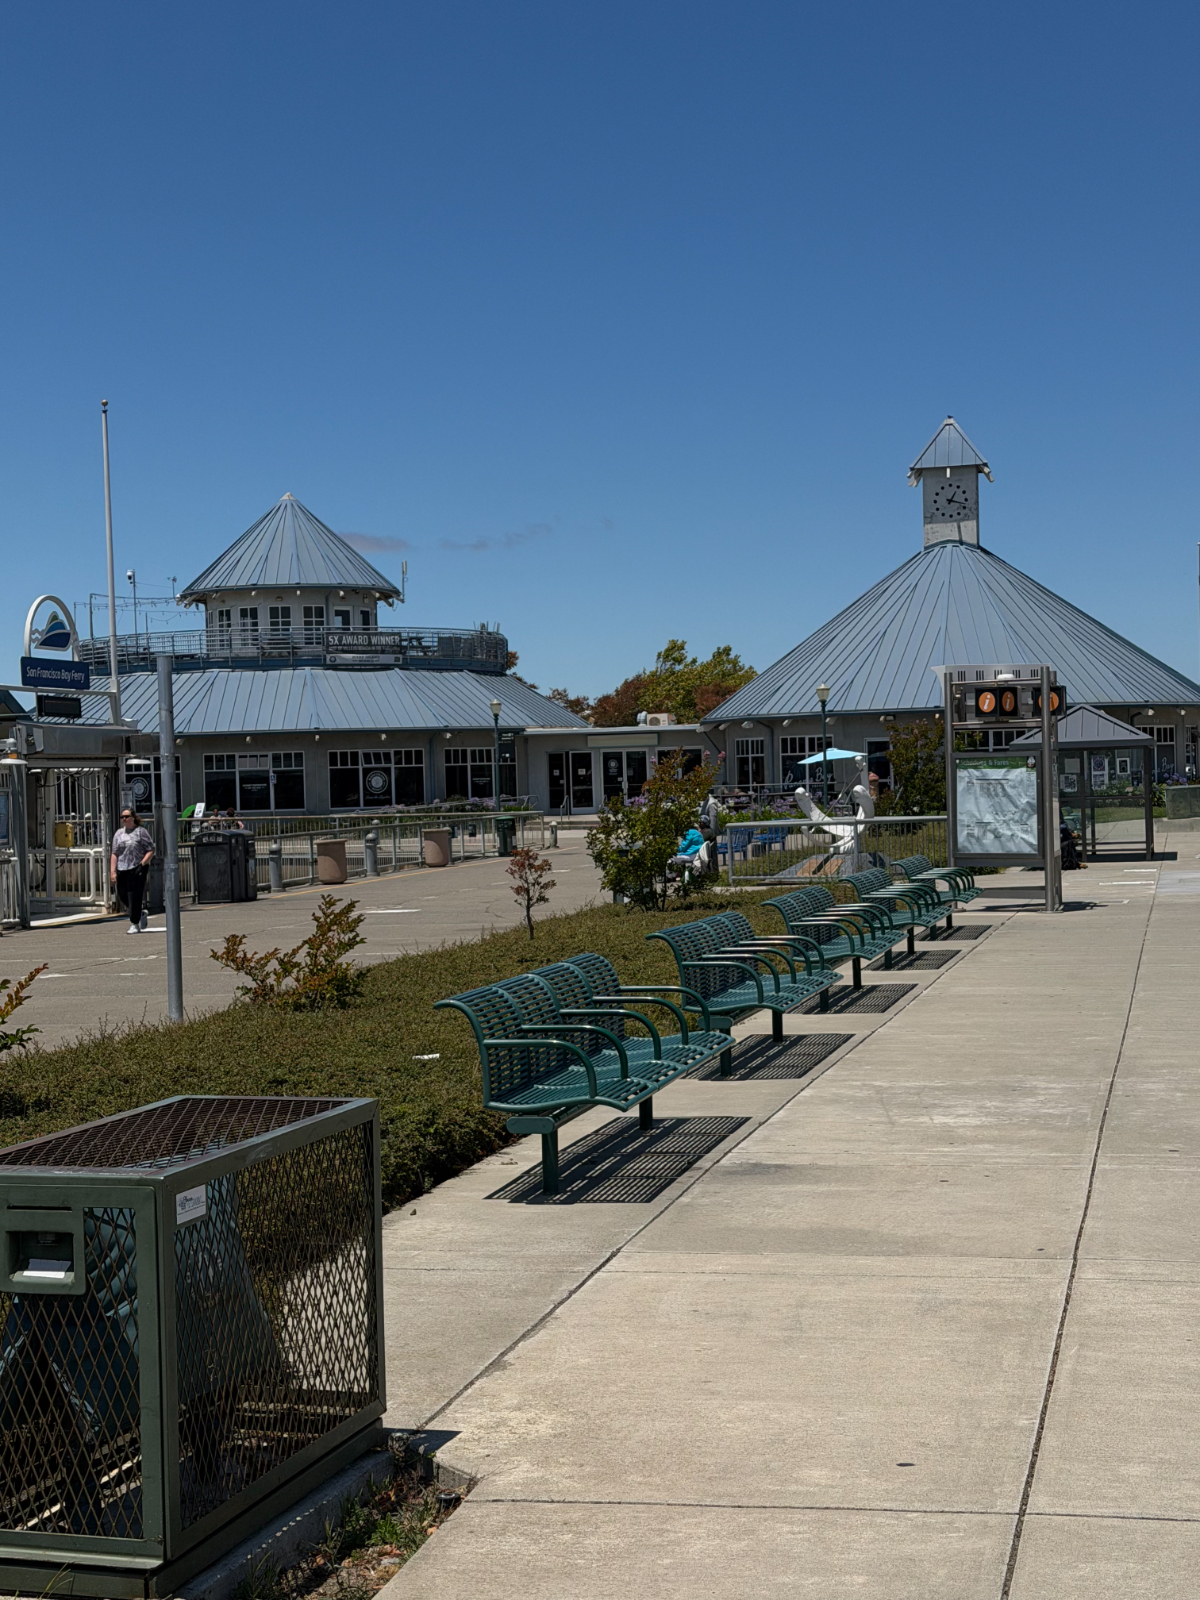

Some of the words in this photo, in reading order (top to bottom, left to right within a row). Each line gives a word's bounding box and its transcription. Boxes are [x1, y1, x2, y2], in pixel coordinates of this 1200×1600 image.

[341, 635, 368, 645] AWARD
[371, 635, 400, 645] WINNER
[26, 666, 37, 677] San
[37, 667, 60, 679] Francisco
[61, 669, 71, 682] Bay
[72, 670, 85, 683] Ferry
[815, 766, 833, 783] By
